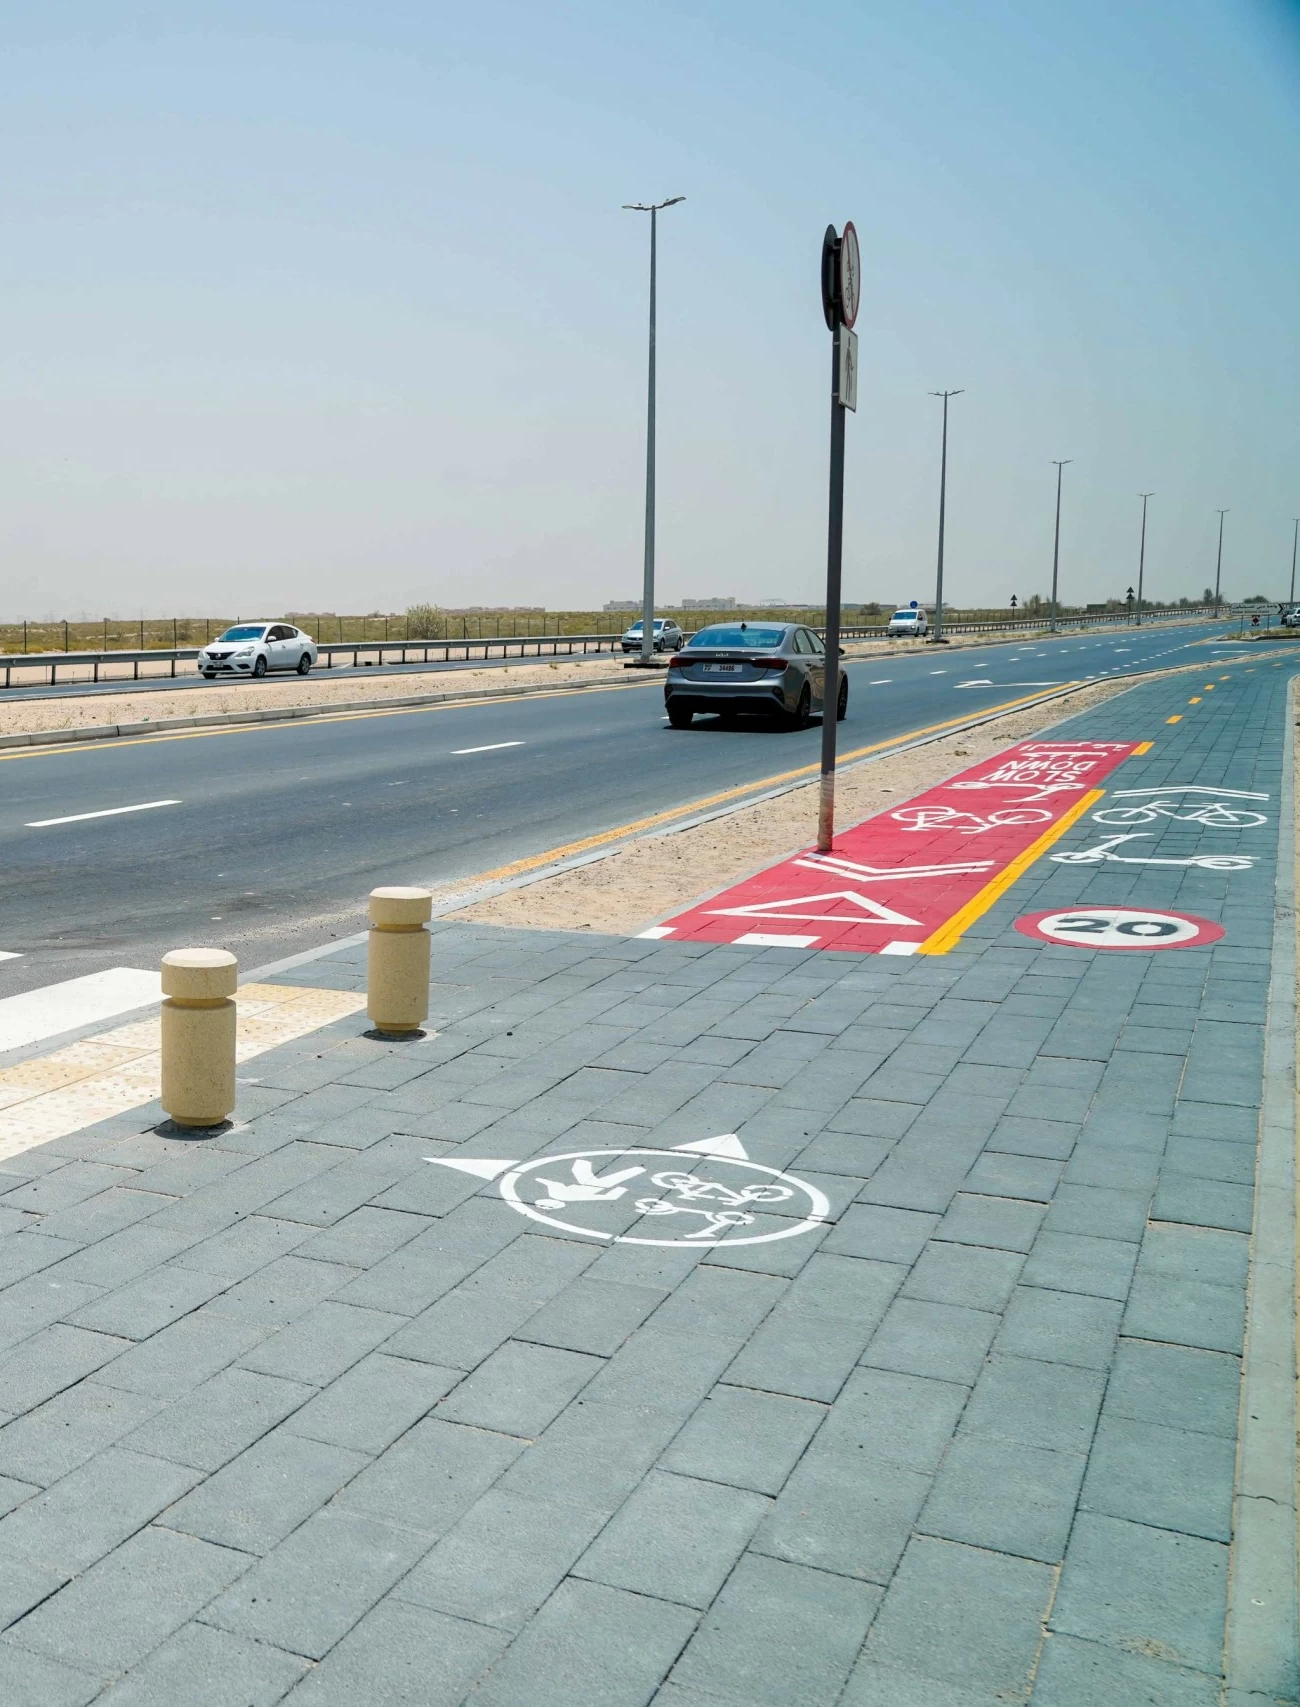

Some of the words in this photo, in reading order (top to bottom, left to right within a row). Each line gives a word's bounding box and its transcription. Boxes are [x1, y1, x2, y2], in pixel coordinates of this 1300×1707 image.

[1018, 741, 1130, 752] السرعة
[998, 760, 1097, 771] DOWN
[979, 770, 1082, 782] SLOW
[1053, 917, 1179, 937] 20
